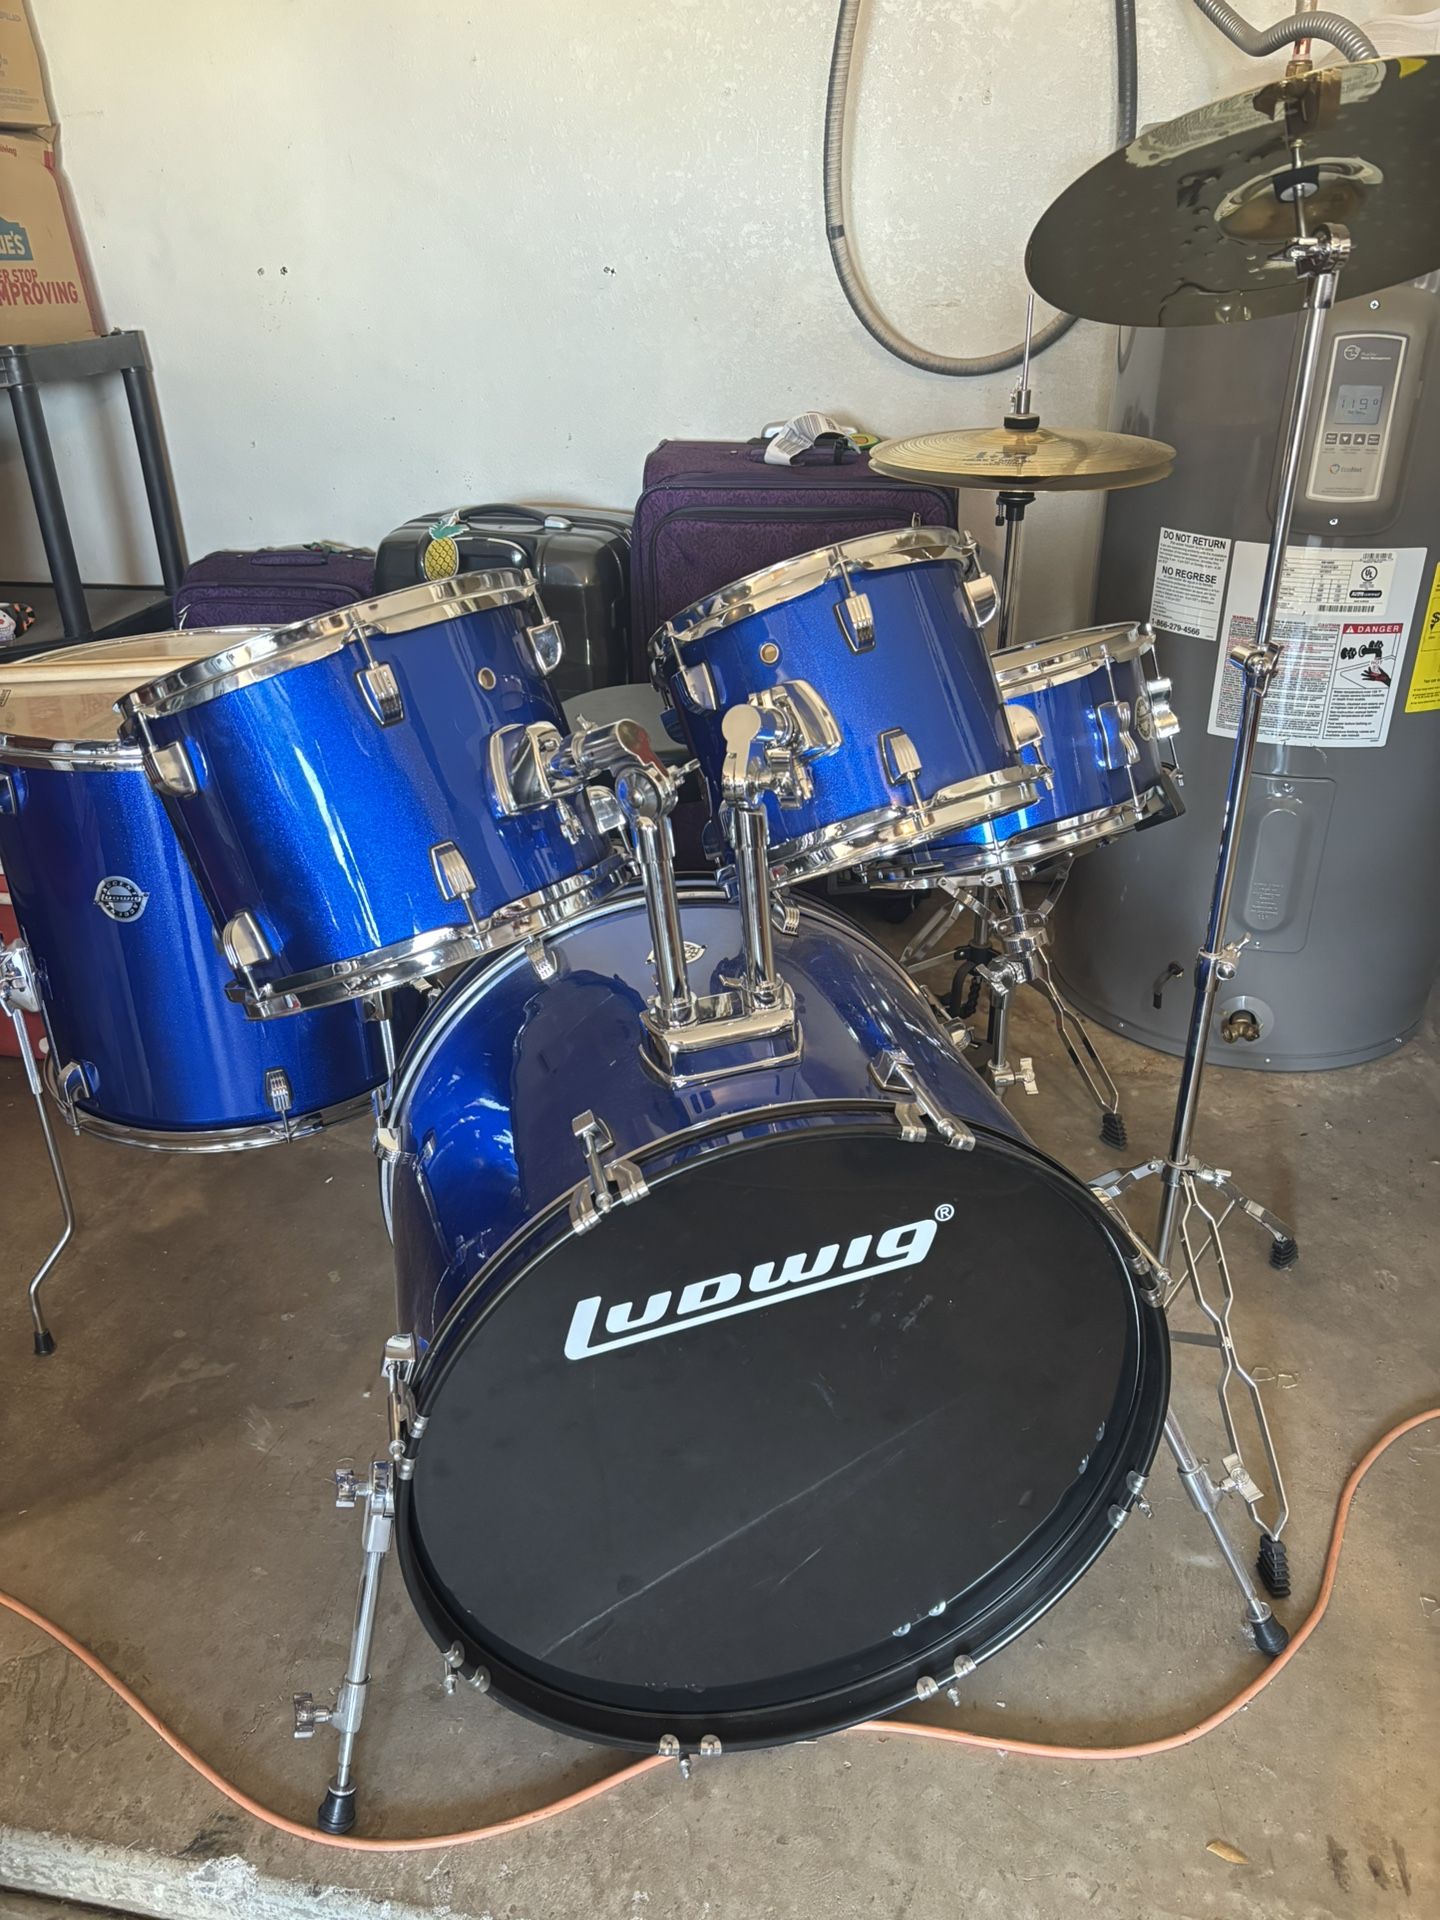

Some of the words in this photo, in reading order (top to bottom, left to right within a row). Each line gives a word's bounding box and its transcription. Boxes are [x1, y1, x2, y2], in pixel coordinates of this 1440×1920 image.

[11, 268, 38, 283] STOP
[1163, 530, 1175, 540] DO
[1175, 533, 1191, 543] NOT
[1192, 536, 1226, 549] RETURN
[1162, 566, 1174, 575] NO
[1175, 568, 1217, 584] REGRESE
[1357, 625, 1400, 633] DANGER
